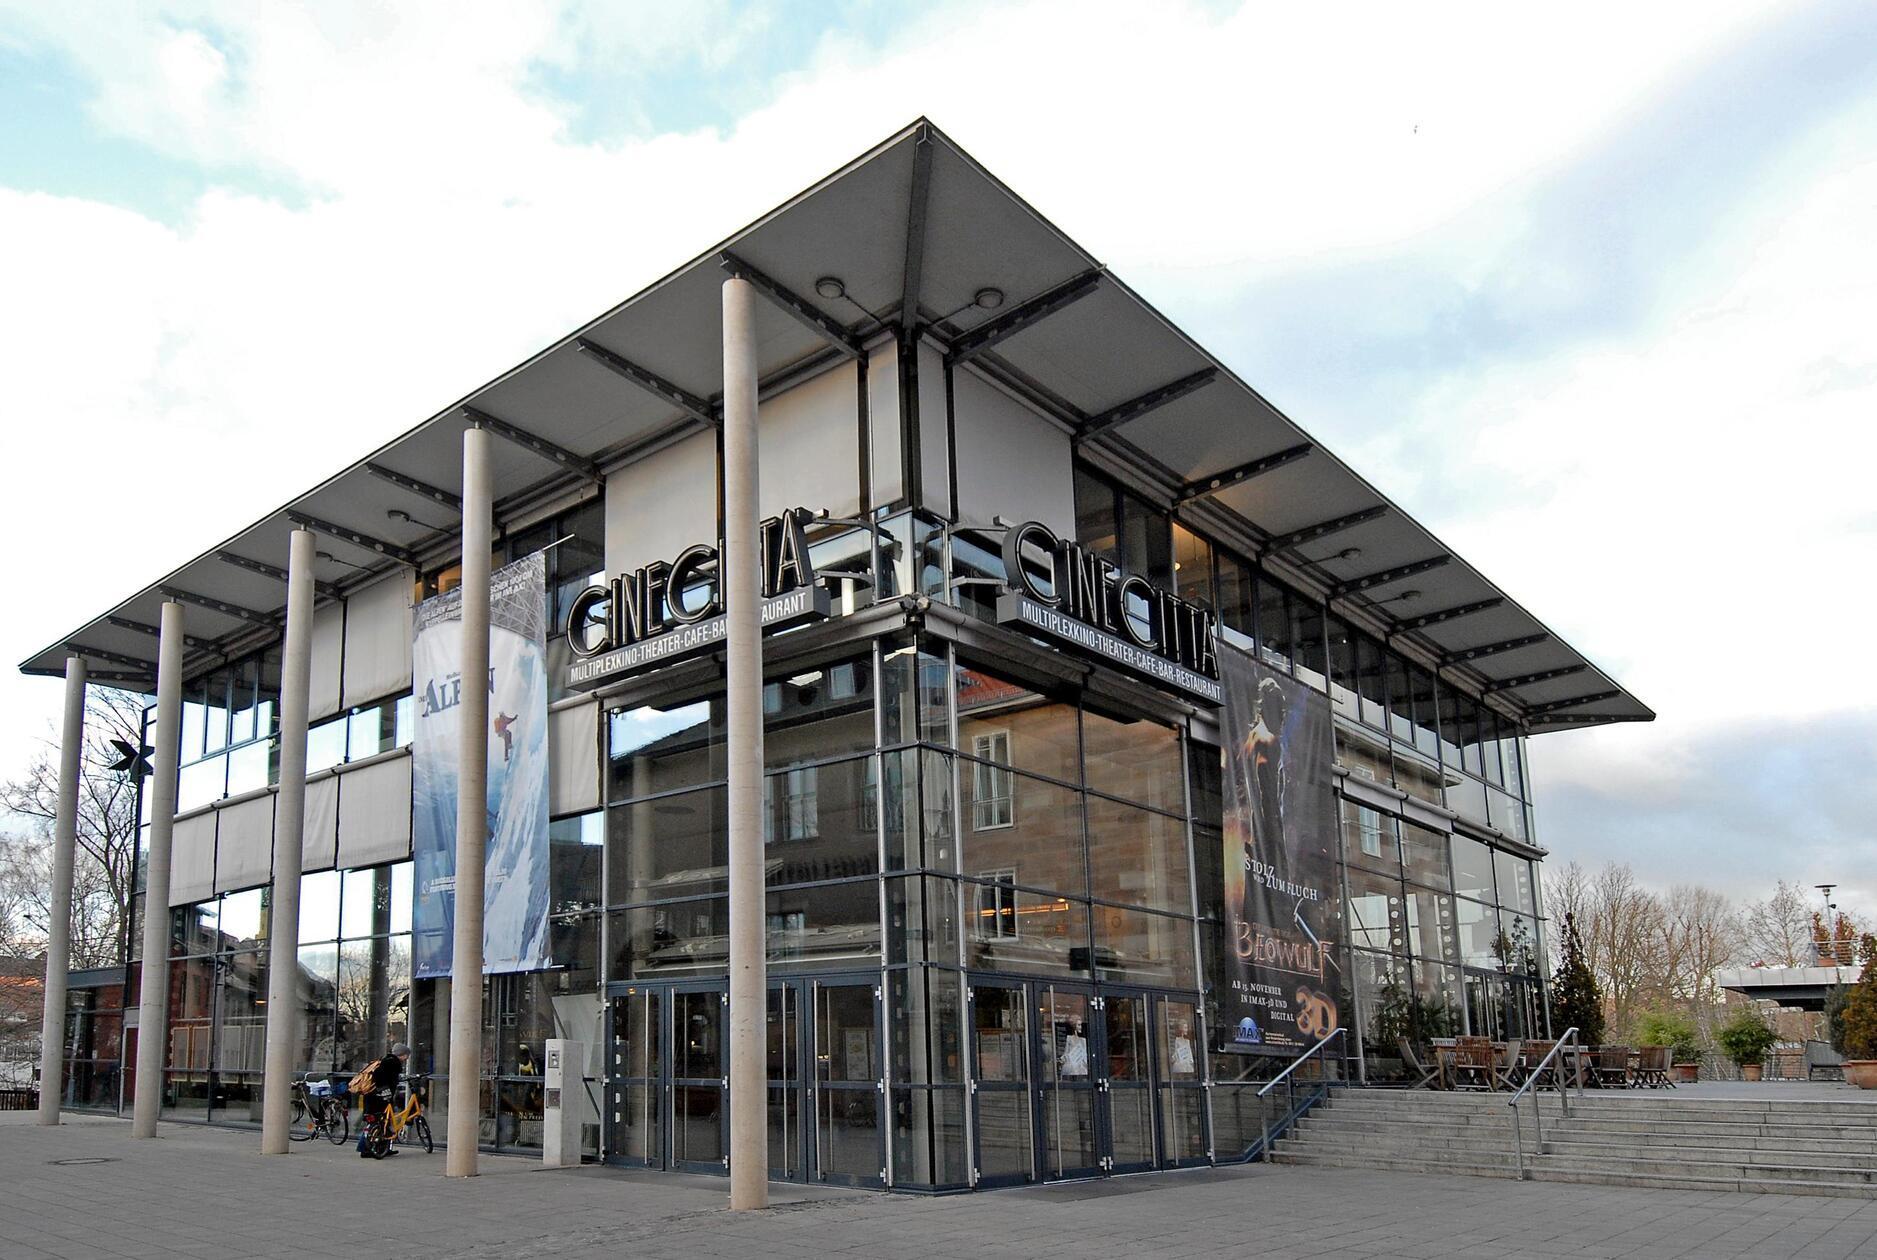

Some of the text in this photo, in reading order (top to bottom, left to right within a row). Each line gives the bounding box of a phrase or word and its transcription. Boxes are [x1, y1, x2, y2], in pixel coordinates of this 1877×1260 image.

[570, 592, 806, 683] MULTIPLEXKINO-THEATER-CAFE-BAAURANT
[1245, 858, 1275, 880] STOLZ
[1266, 873, 1286, 893] ZUM
[1287, 882, 1318, 901] FLUCH
[1235, 914, 1335, 984] BEOWULF
[1232, 980, 1241, 989] AB
[1250, 983, 1282, 996] NOVEMBER
[1241, 994, 1248, 1003] IN
[1275, 1000, 1288, 1009] UND
[1295, 985, 1337, 1040] 3D
[1270, 1011, 1295, 1022] DIGITAL
